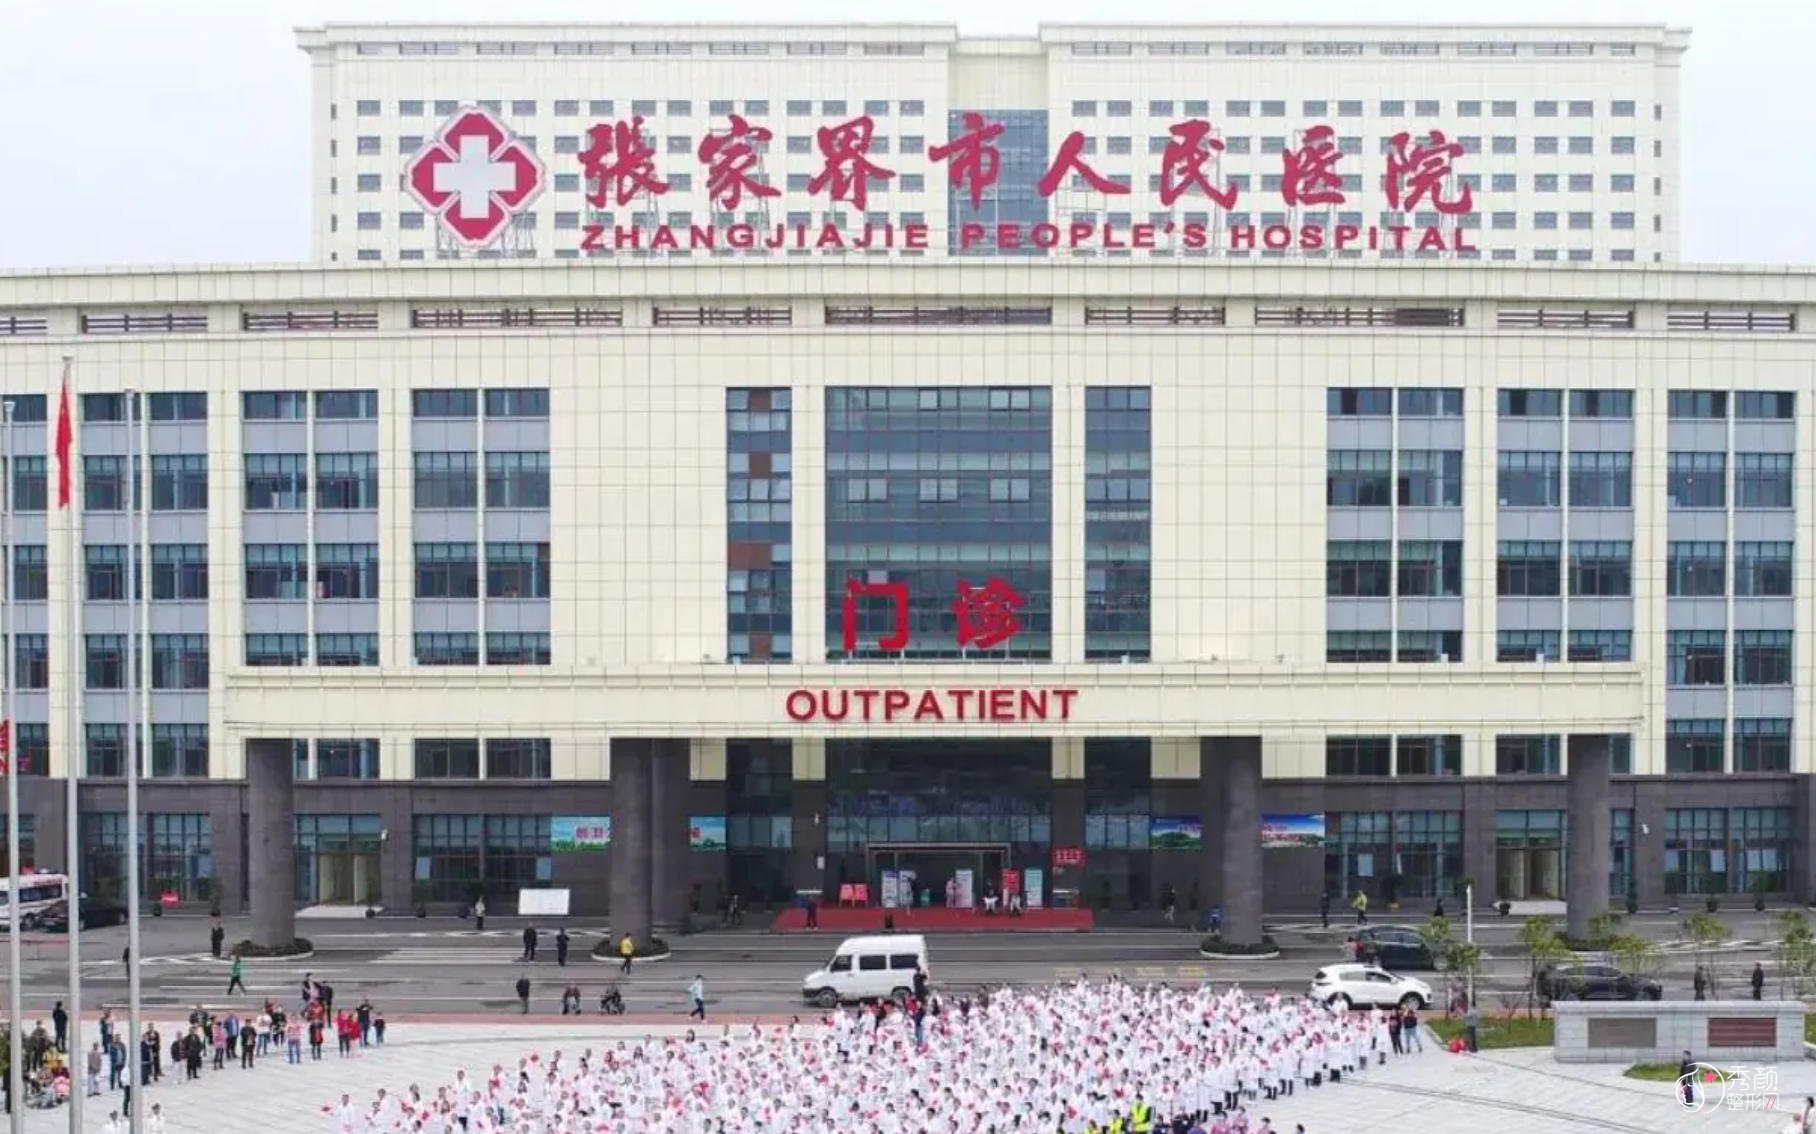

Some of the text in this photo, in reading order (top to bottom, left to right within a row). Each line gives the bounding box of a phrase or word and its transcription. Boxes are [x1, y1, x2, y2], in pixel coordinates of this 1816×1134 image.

[581, 222, 1477, 250] ZHANGJIAJIE PEOPLE'S HOSPITAL
[842, 577, 1024, 652] 门诊
[785, 689, 1078, 721] OUTPATIENT
